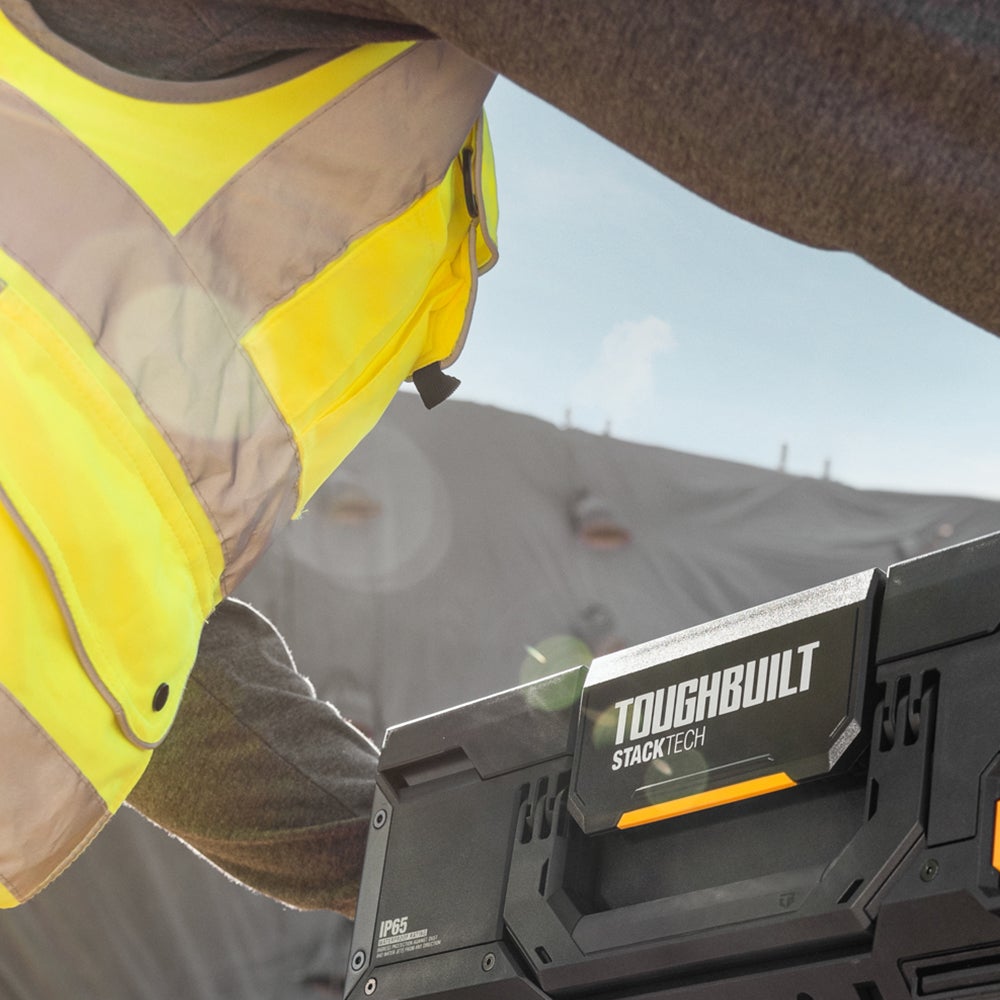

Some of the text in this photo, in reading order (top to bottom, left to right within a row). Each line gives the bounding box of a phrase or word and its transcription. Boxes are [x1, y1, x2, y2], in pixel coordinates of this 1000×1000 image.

[614, 640, 820, 745] TOUGHBUILT
[611, 726, 706, 771] STACKTECH
[379, 916, 408, 938] IP65
